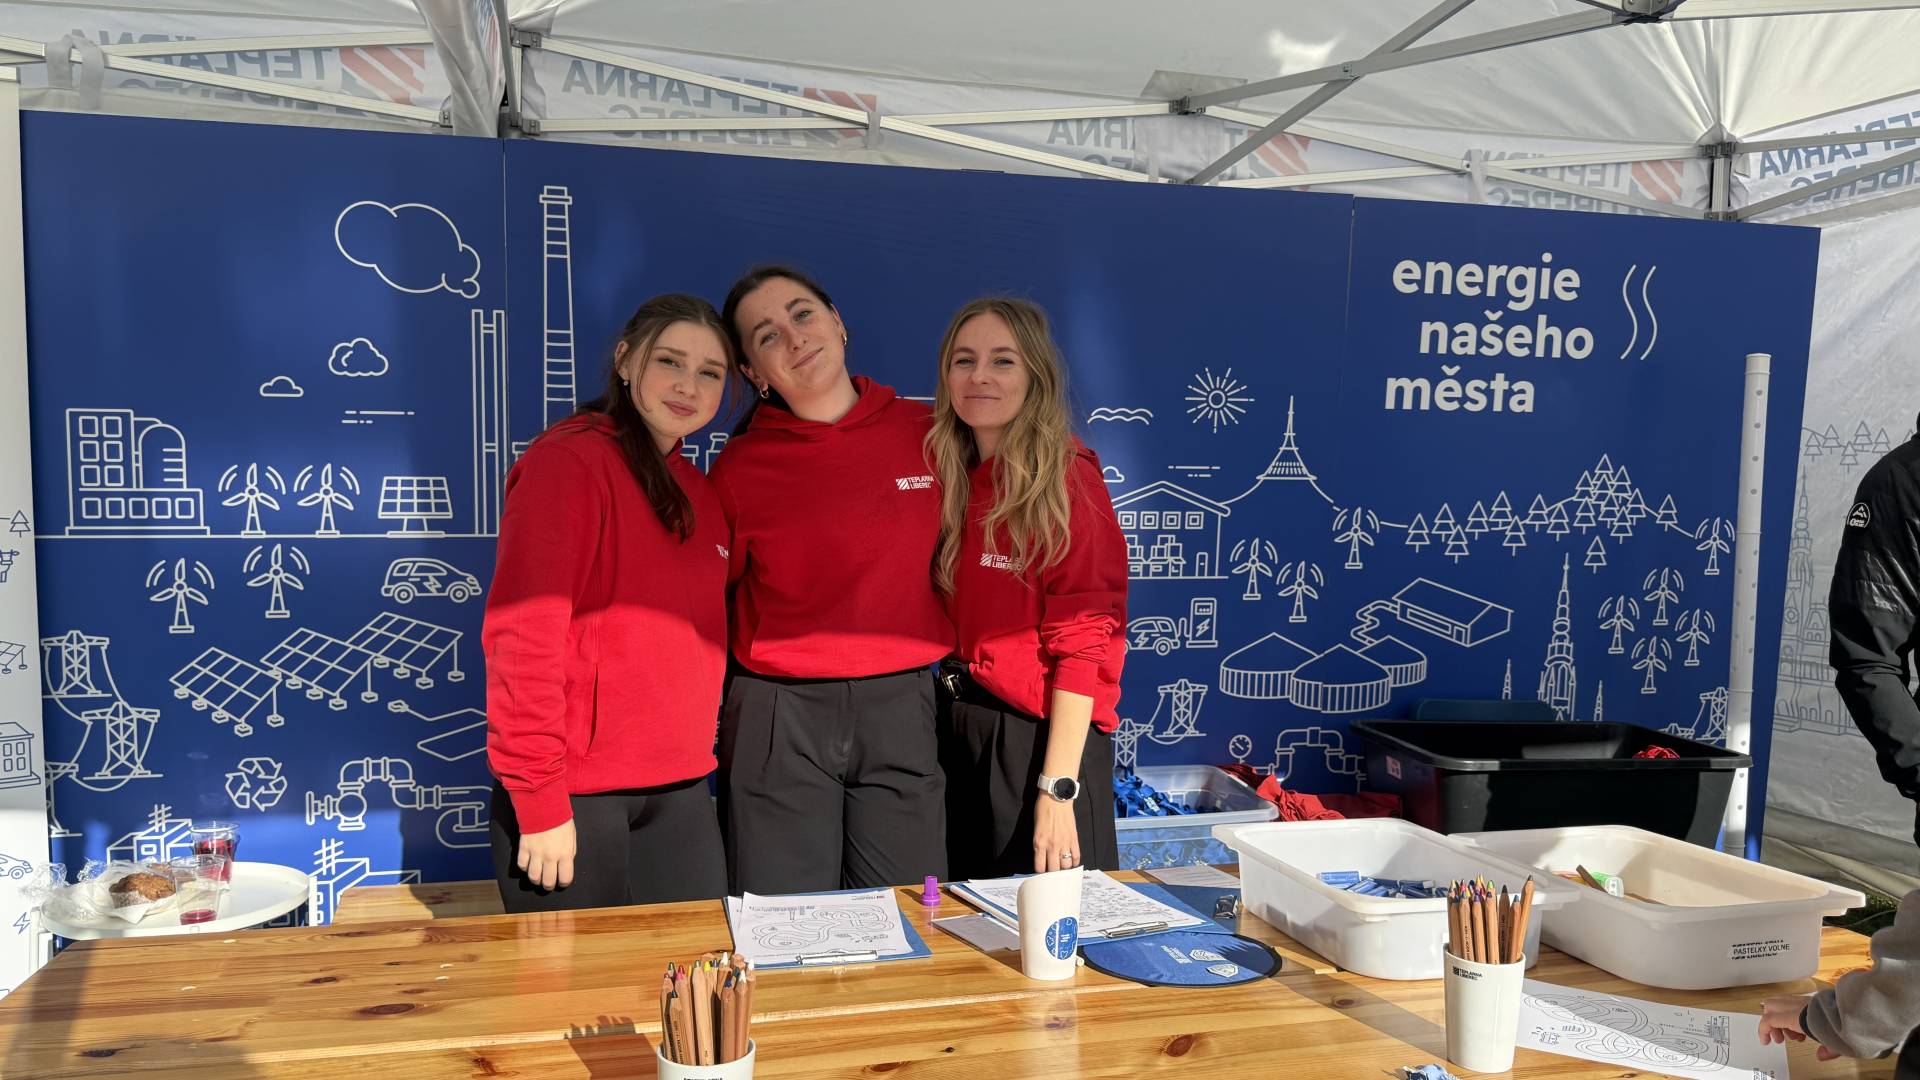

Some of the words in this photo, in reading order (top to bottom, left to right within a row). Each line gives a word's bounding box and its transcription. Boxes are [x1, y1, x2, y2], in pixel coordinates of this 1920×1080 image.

[1392, 252, 1580, 311] energie
[1419, 309, 1594, 360] našeho
[1385, 364, 1535, 412] města
[1733, 945, 1767, 955] PASTELKY
